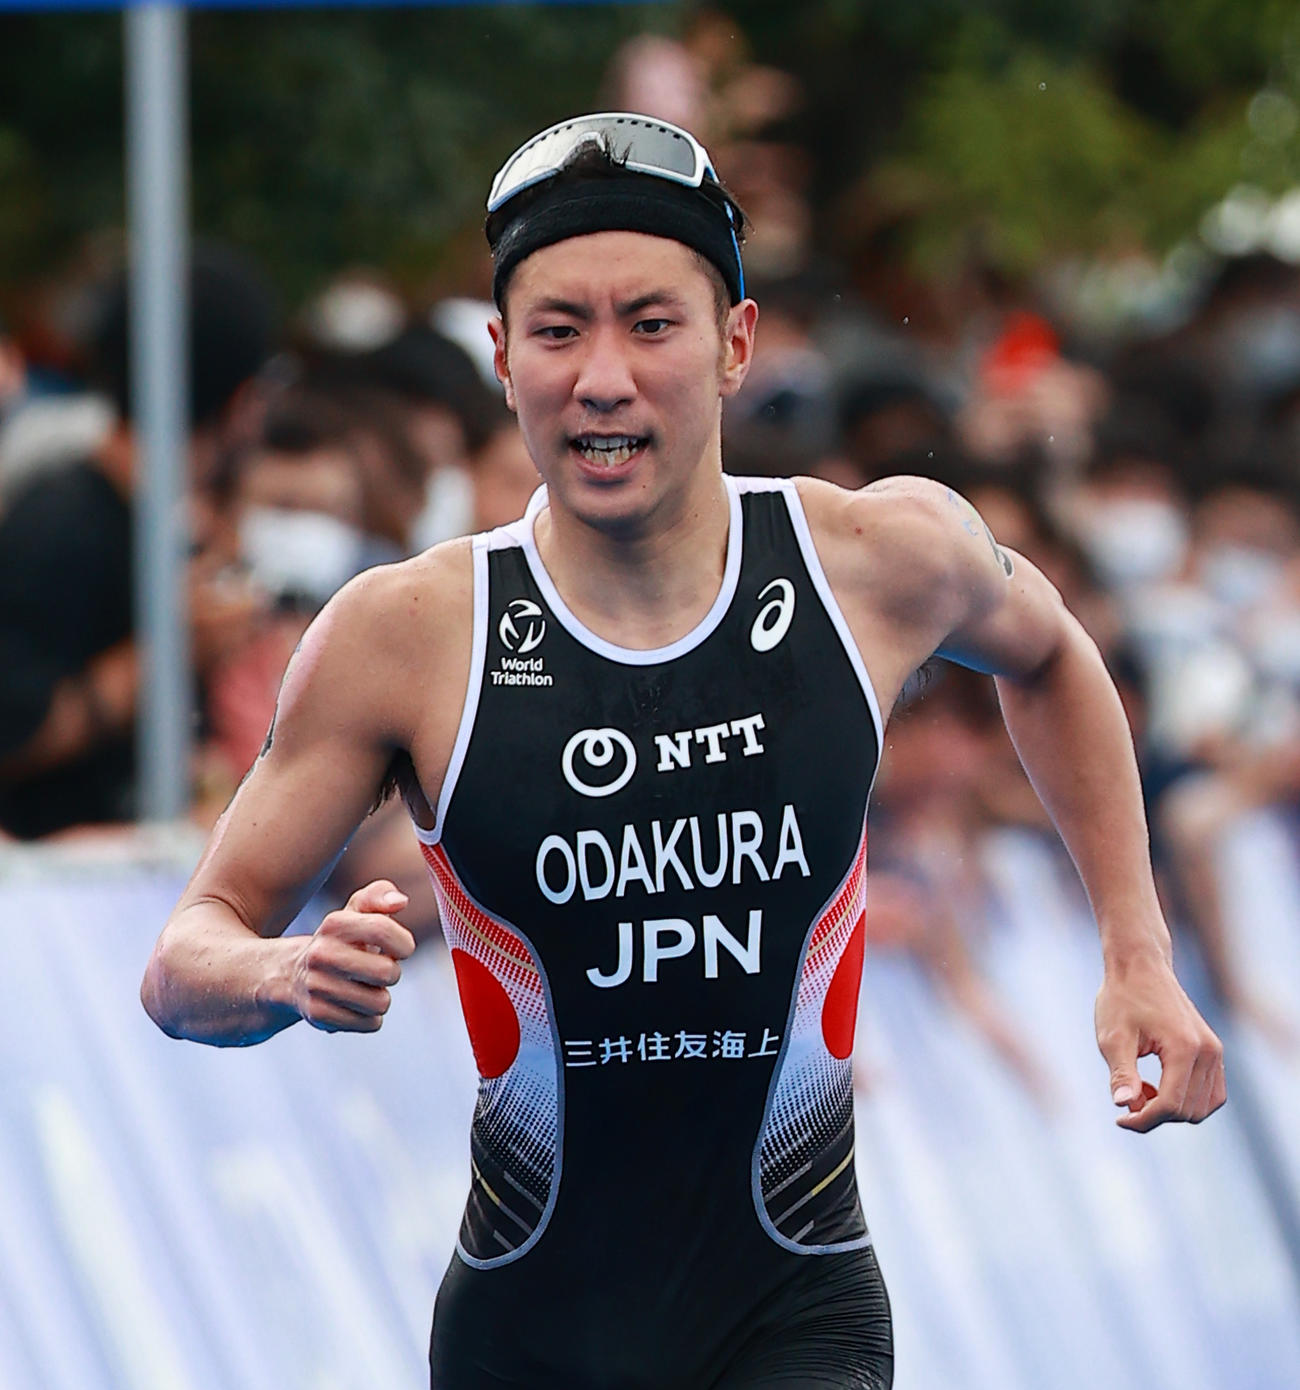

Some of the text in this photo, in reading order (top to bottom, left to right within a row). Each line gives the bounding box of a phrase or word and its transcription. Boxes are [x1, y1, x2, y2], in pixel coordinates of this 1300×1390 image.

[490, 671, 553, 686] Triathlon
[501, 657, 543, 671] World
[654, 714, 766, 772] NTT
[536, 804, 811, 904] ODAKURA
[586, 910, 762, 987] JPN
[564, 1028, 780, 1067] 三井住友海上
